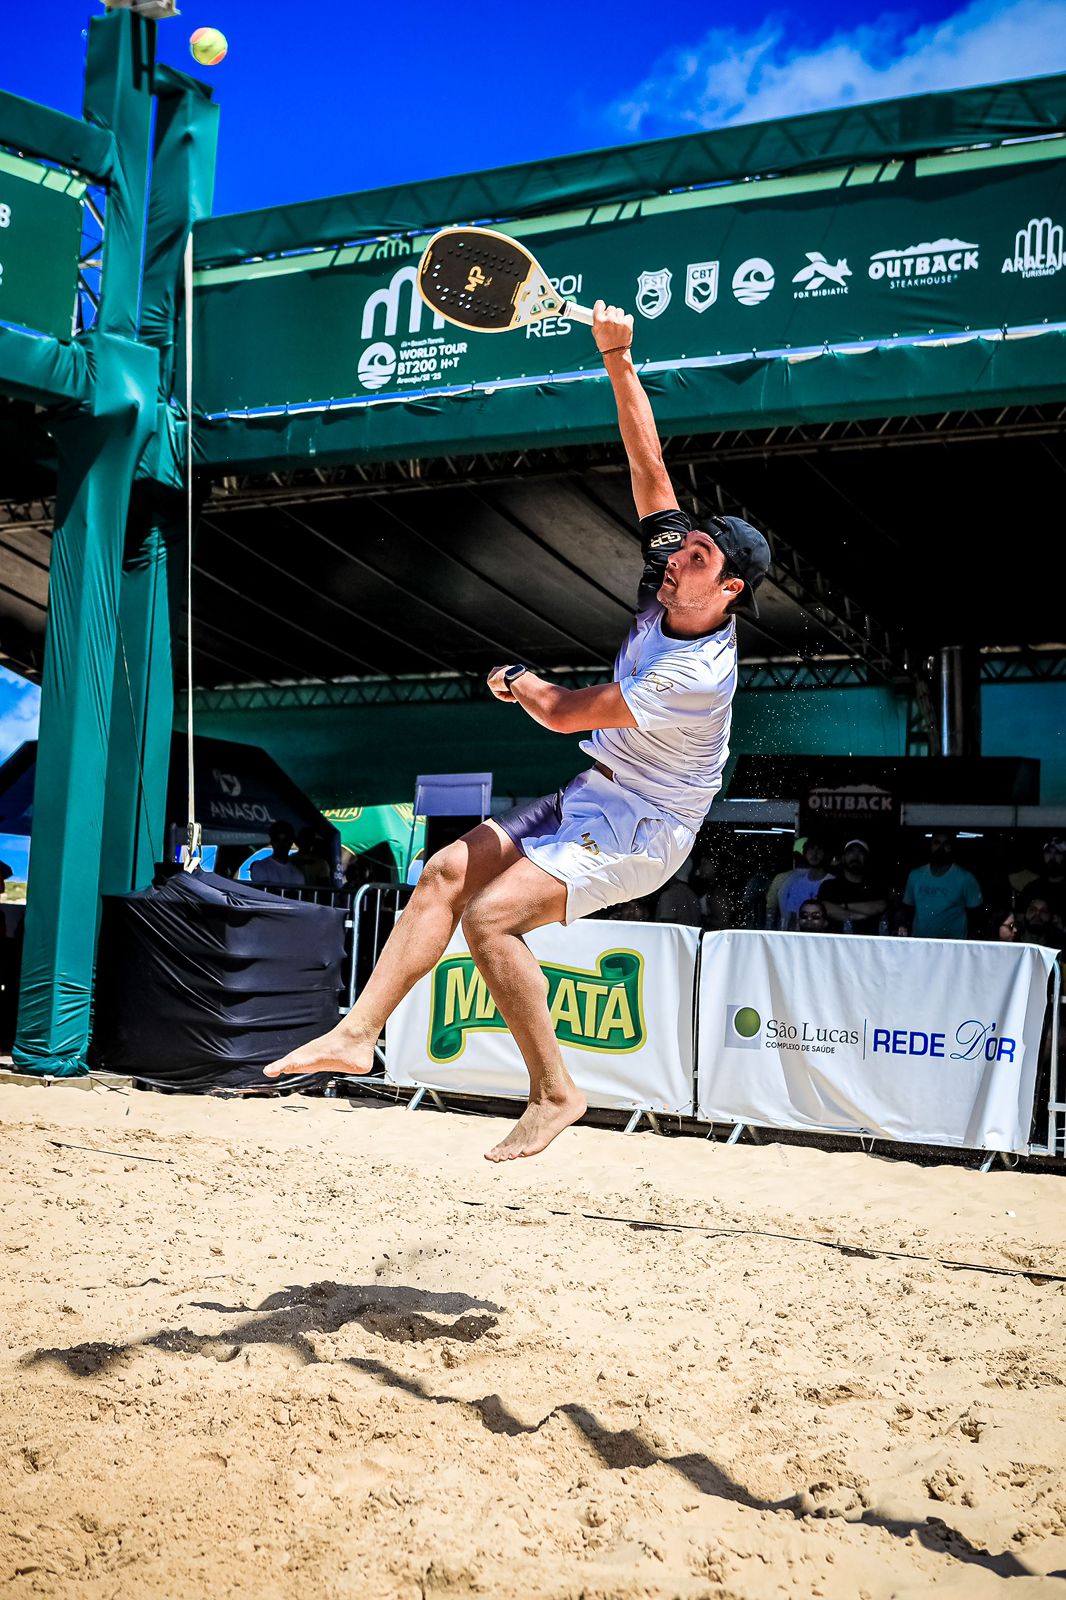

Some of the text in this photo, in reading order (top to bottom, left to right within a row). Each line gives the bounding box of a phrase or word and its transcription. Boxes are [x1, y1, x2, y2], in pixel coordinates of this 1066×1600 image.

[868, 251, 979, 280] OUTBACK
[1001, 251, 1066, 273] ARACAJ
[643, 276, 664, 287] FST
[691, 268, 714, 280] CBT
[1022, 268, 1056, 278] TURISMO
[890, 276, 952, 289] STEAKHOUSE
[793, 287, 849, 300] FOX MIDIATIC
[399, 342, 468, 360] WORLD TOUR
[397, 358, 437, 375] BT200
[808, 795, 894, 811] OUTBACK
[211, 801, 276, 823] ANASOL
[444, 966, 635, 1040] MATÁ
[766, 1019, 859, 1044] São Lucas
[765, 1041, 800, 1051] COMPLEXO
[811, 1044, 835, 1054] SAÚDE
[873, 1028, 945, 1058] REDE
